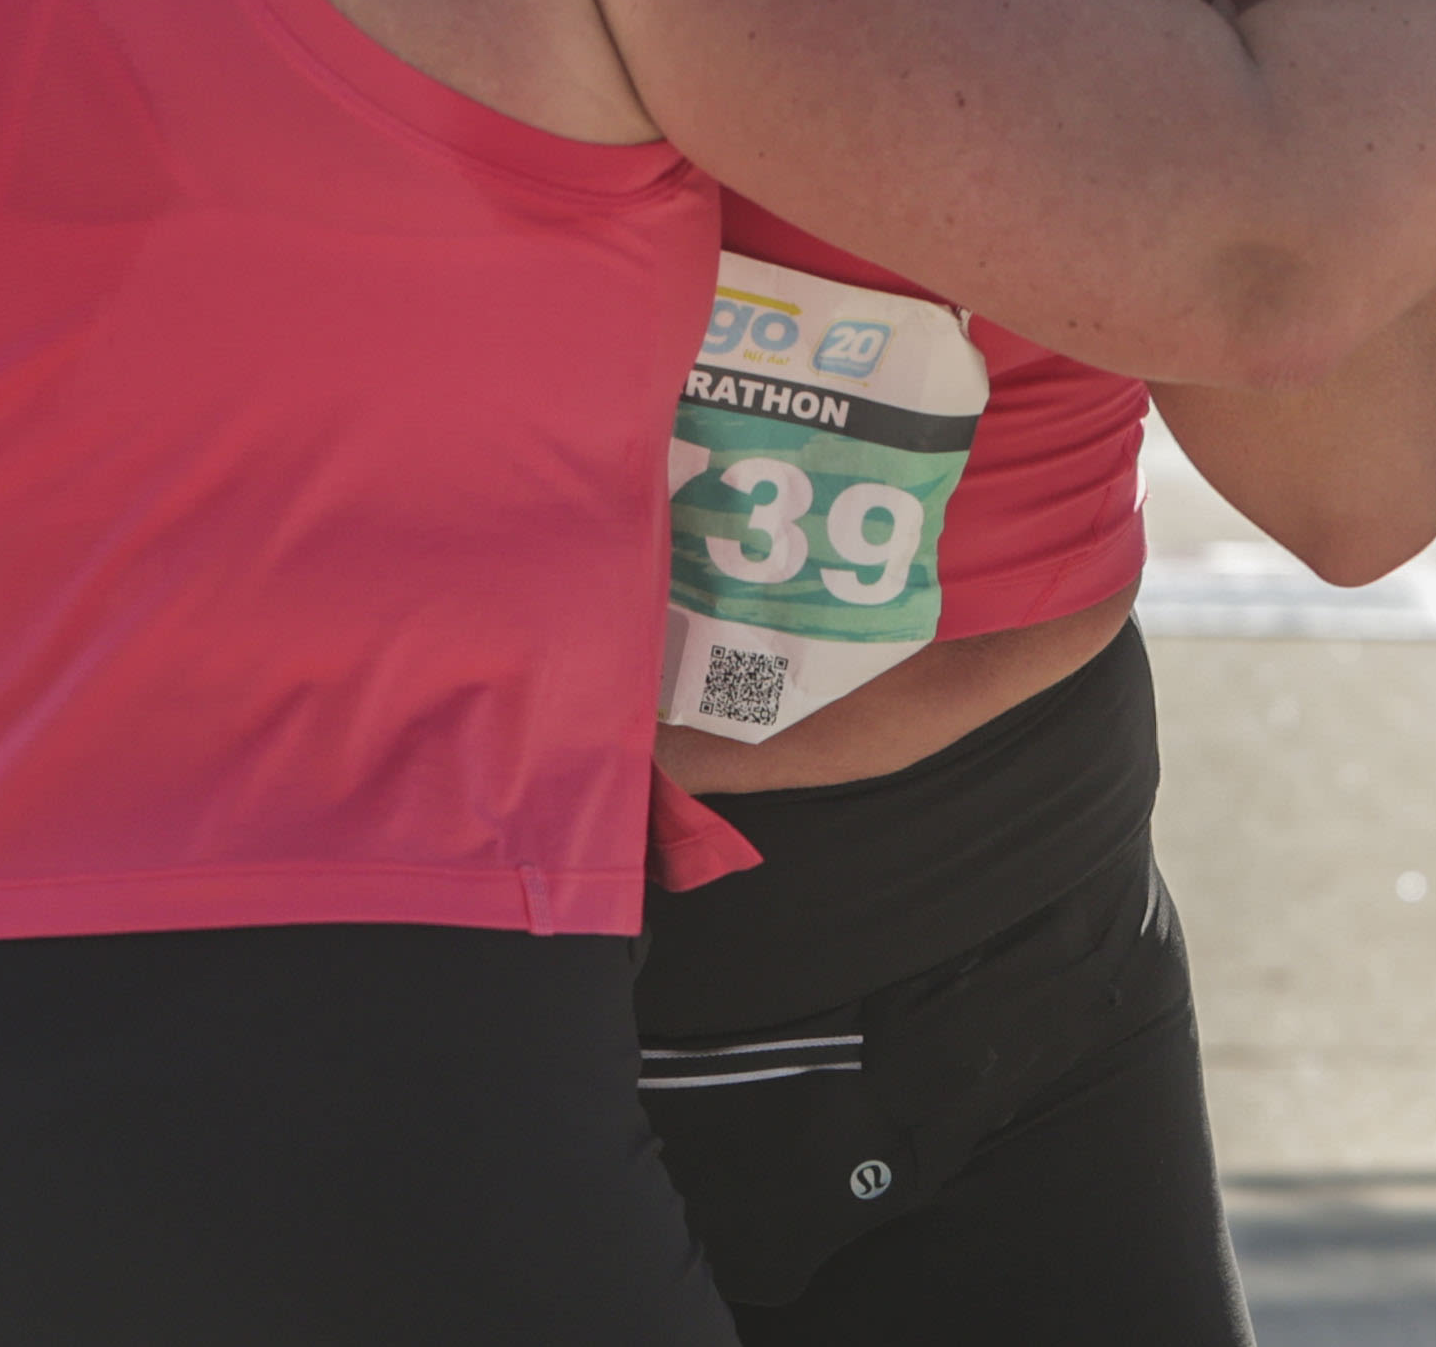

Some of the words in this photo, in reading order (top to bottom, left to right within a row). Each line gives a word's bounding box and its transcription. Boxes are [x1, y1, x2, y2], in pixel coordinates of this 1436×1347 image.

[702, 285, 801, 355] go
[822, 326, 884, 363] 20
[685, 369, 850, 429] RATHON
